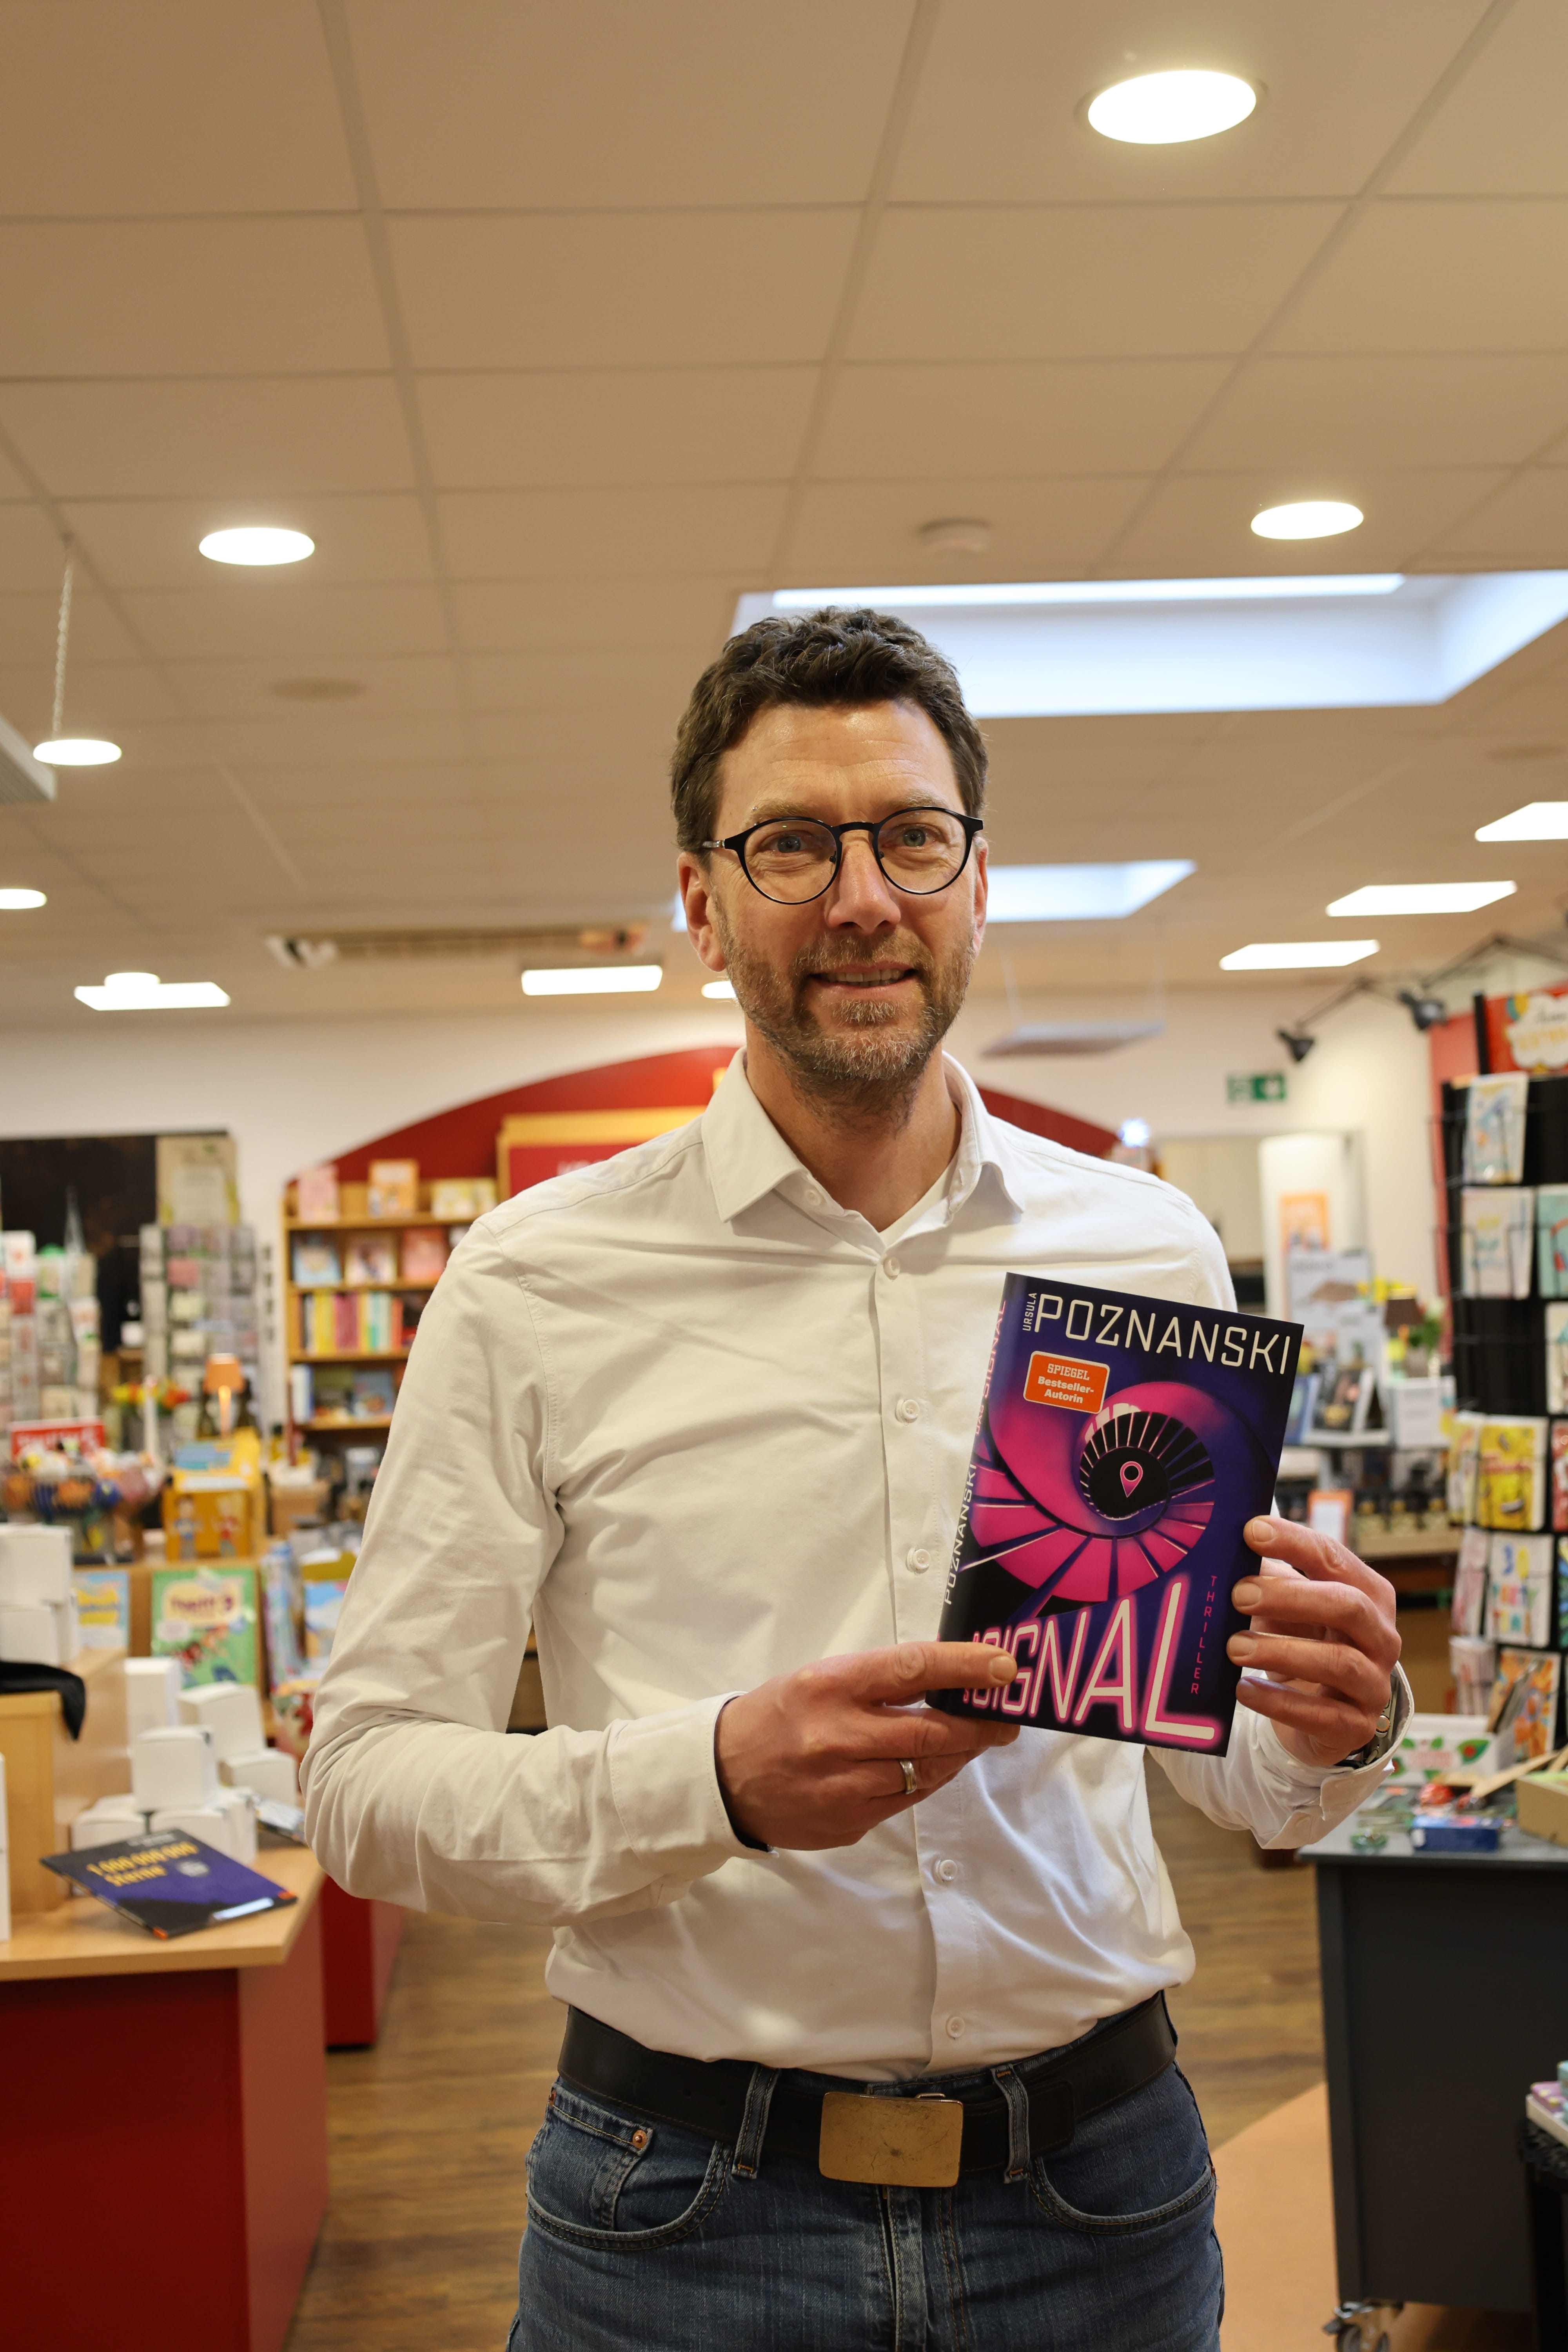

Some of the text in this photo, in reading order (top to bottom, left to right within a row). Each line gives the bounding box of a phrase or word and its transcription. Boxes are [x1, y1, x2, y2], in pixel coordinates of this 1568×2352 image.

[1022, 1293, 1037, 1331] URSULA
[1034, 1293, 1290, 1375] POZNANSKI
[982, 1299, 1006, 1399] SIGNAL
[1047, 1363, 1090, 1381] SPIEGEL
[1038, 1376, 1094, 1394] Bestseller-
[1044, 1388, 1083, 1404] Autorin
[944, 1463, 977, 1605] POZNANSKI
[1191, 1575, 1217, 1695] THRILLER
